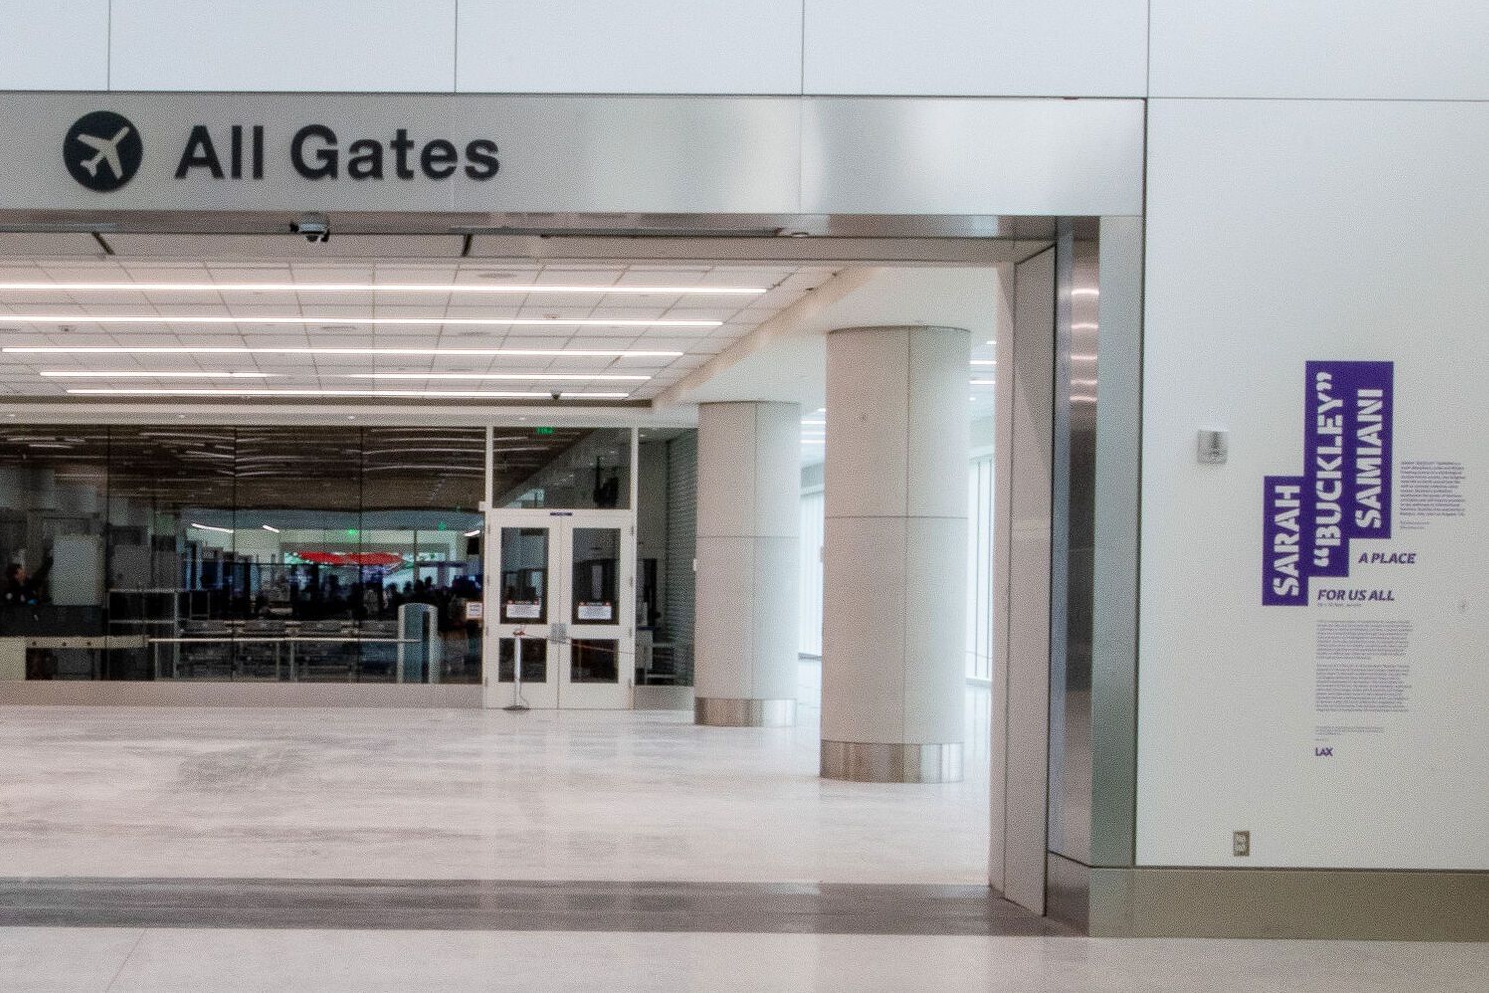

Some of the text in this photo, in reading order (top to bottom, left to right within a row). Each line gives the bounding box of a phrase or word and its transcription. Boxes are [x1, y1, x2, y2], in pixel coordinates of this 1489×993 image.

[174, 123, 501, 181] All Gates
[1355, 388, 1384, 529] SAMIANI
[1272, 484, 1301, 597] SARAH
[1358, 552, 1416, 564] A PLACE
[1317, 589, 1395, 601] FOR US ALL
[1315, 747, 1333, 757] LAX
